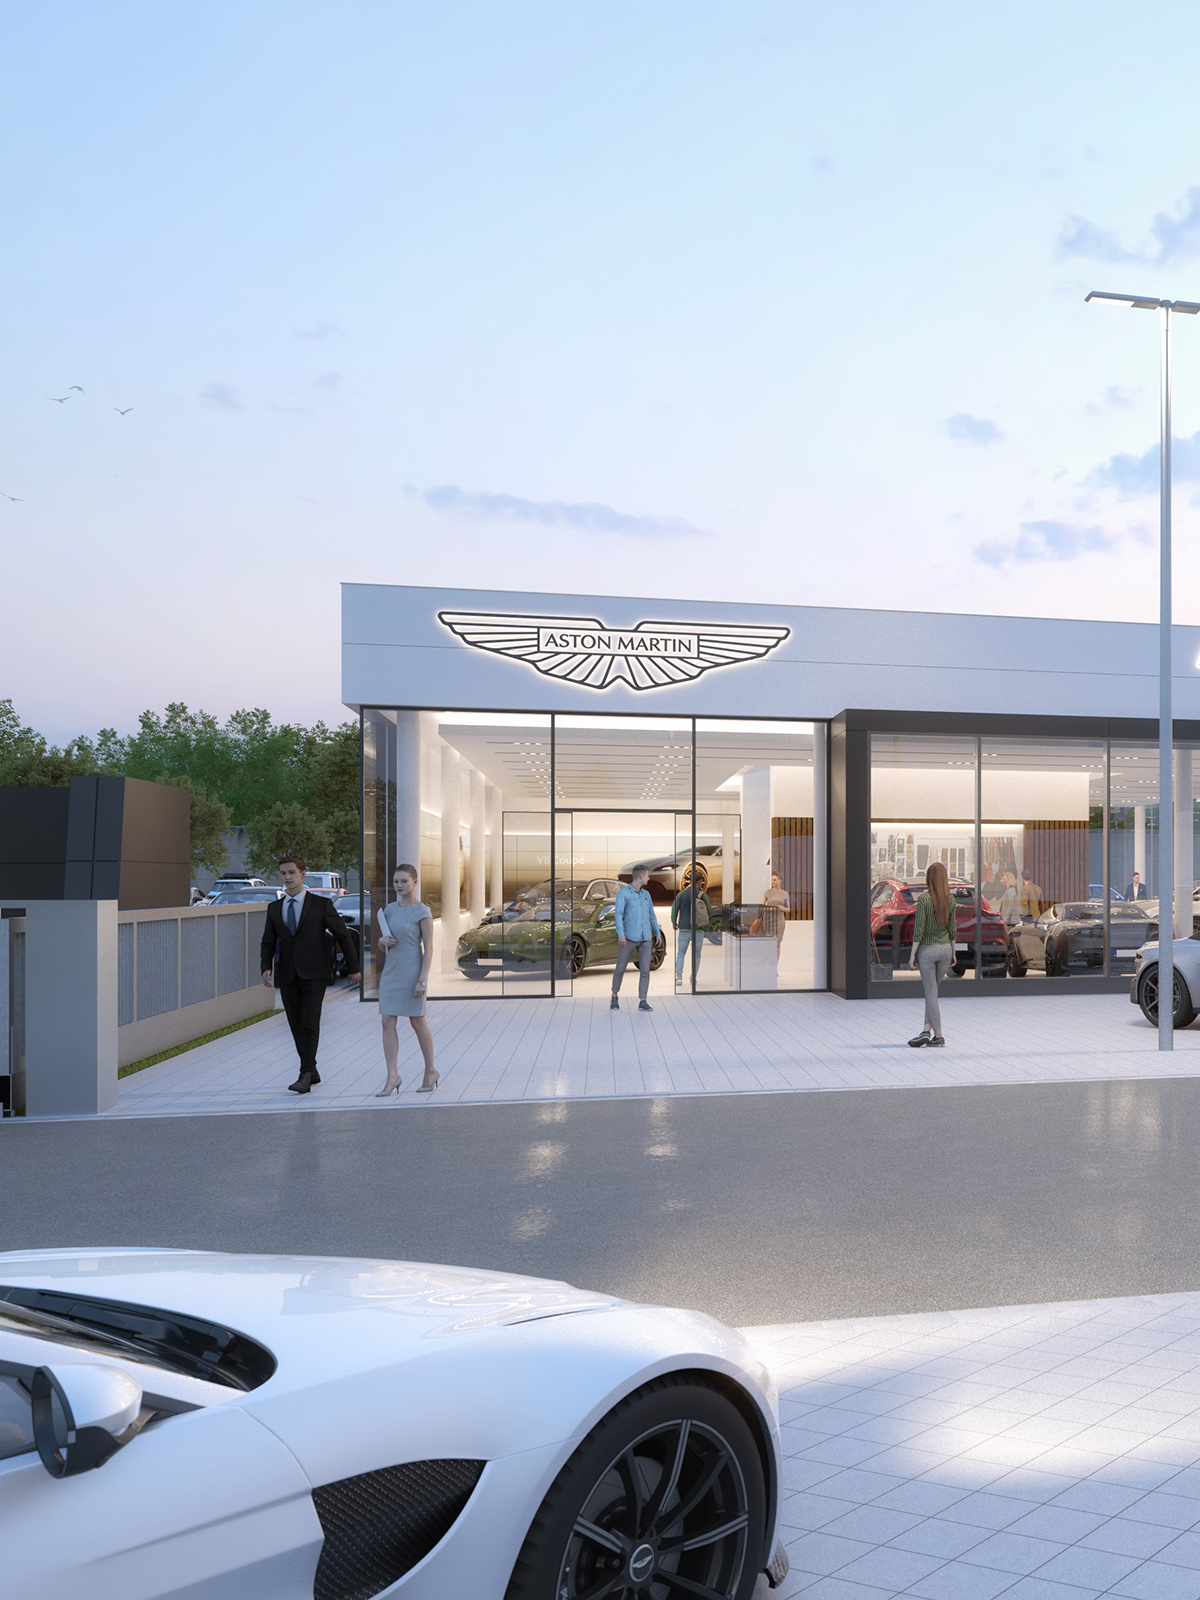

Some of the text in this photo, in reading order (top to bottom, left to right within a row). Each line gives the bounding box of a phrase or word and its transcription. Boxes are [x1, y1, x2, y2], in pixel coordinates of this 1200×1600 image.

[545, 633, 692, 653] ASTON MARTIN
[536, 855, 550, 864] V8
